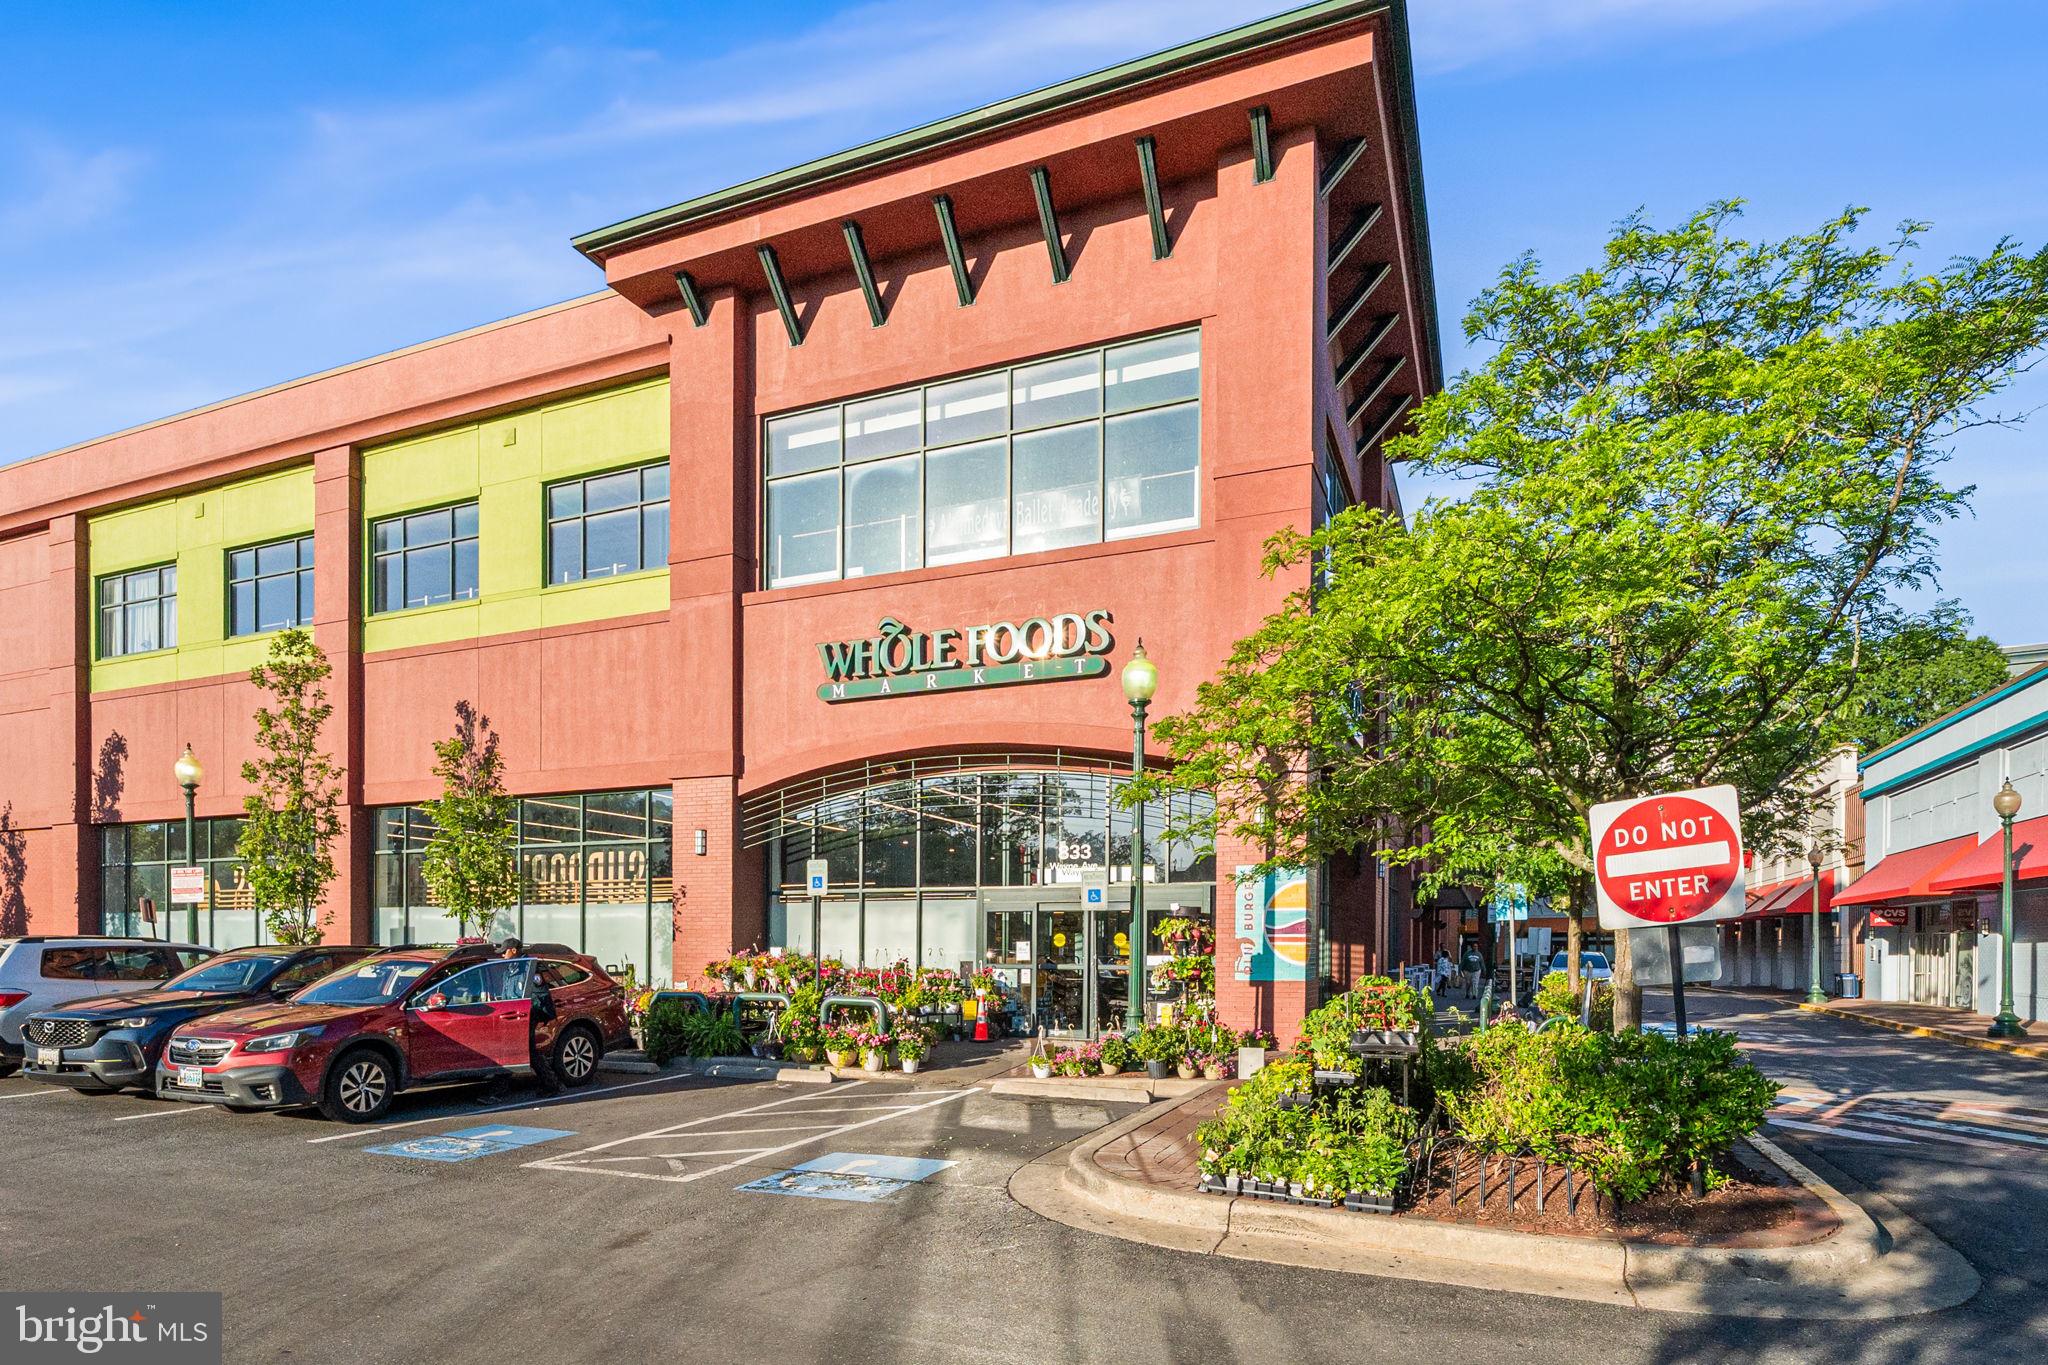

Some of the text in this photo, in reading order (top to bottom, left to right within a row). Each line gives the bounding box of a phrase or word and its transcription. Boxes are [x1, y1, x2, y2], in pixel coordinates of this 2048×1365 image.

[1061, 489, 1119, 520] Acadey
[816, 610, 1111, 679] WHOLE FOODS
[832, 658, 1087, 698] MARKET
[1614, 816, 1713, 848] DO NOT
[1058, 845, 1092, 860] 833
[1244, 874, 1254, 931] BURGE
[1629, 874, 1710, 901] ENTER
[1884, 909, 1906, 917] CVS
